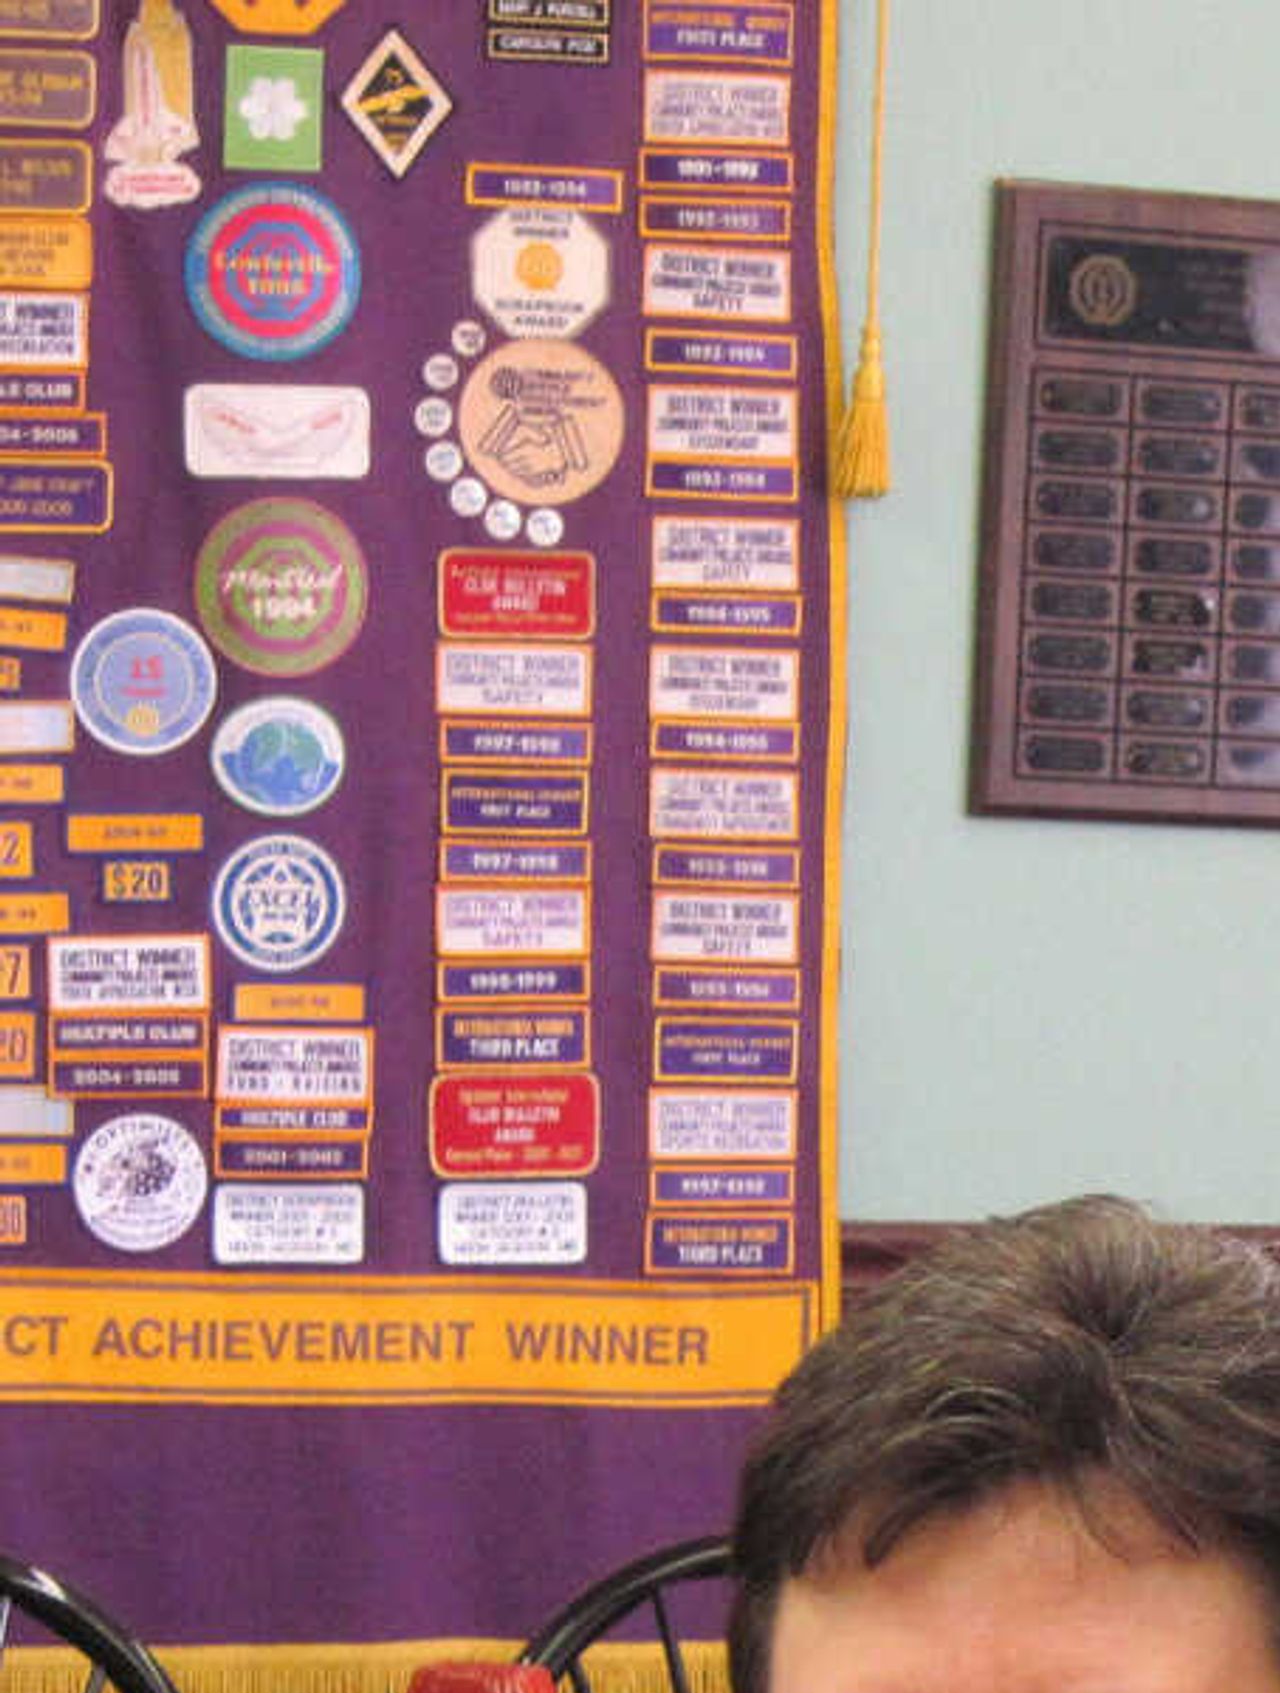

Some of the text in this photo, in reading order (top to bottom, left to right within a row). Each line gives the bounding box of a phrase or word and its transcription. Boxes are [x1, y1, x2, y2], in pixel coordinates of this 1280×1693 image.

[112, 863, 163, 896] $20
[4, 1314, 710, 1367] CT ACHIEVEMENT WINNER
